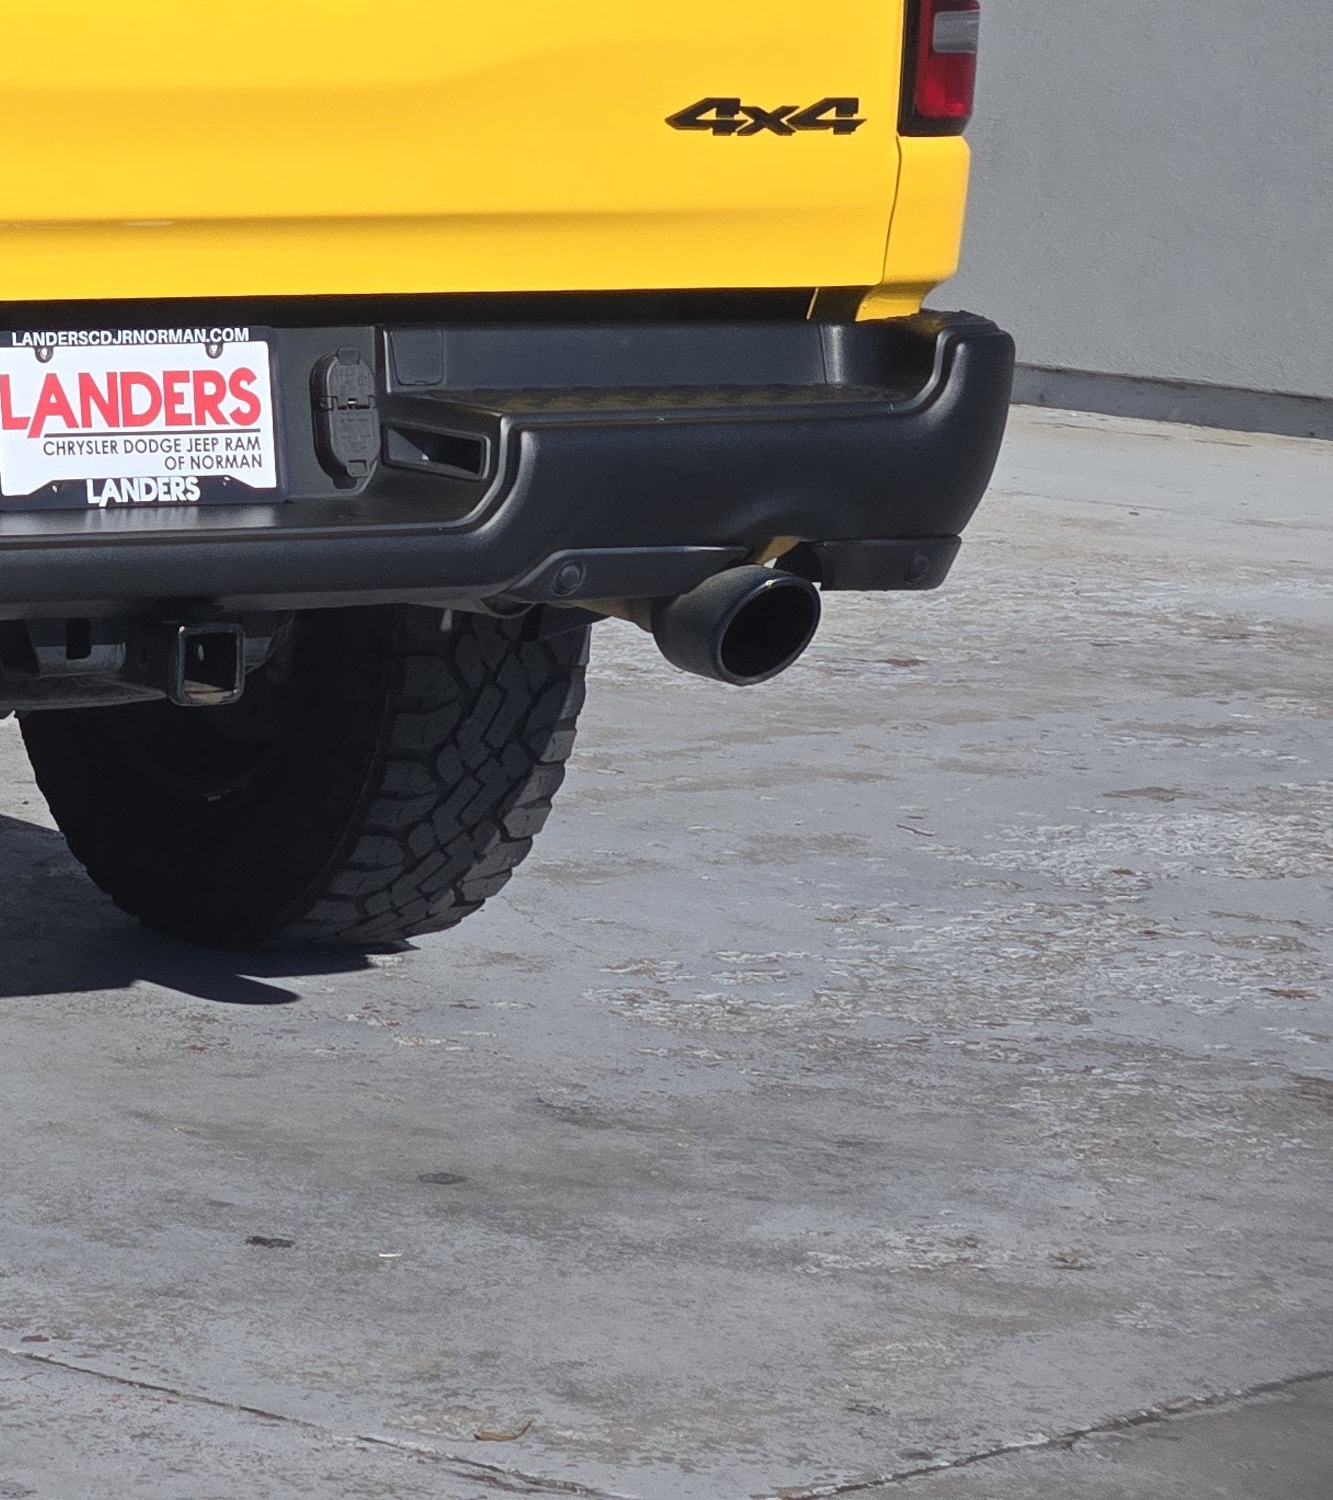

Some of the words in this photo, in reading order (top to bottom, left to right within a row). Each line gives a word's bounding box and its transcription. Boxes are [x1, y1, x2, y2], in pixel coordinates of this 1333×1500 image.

[665, 97, 867, 136] 4x4
[12, 327, 250, 347] LANDERSCDJRNORMAN.COM
[43, 440, 119, 456] CHRYSLER
[124, 438, 183, 454] DODGE
[186, 438, 220, 453] JEEP
[225, 436, 261, 451] RAM
[164, 456, 185, 471] OF
[190, 454, 262, 470] NORMAN
[86, 477, 201, 507] LANDERS
